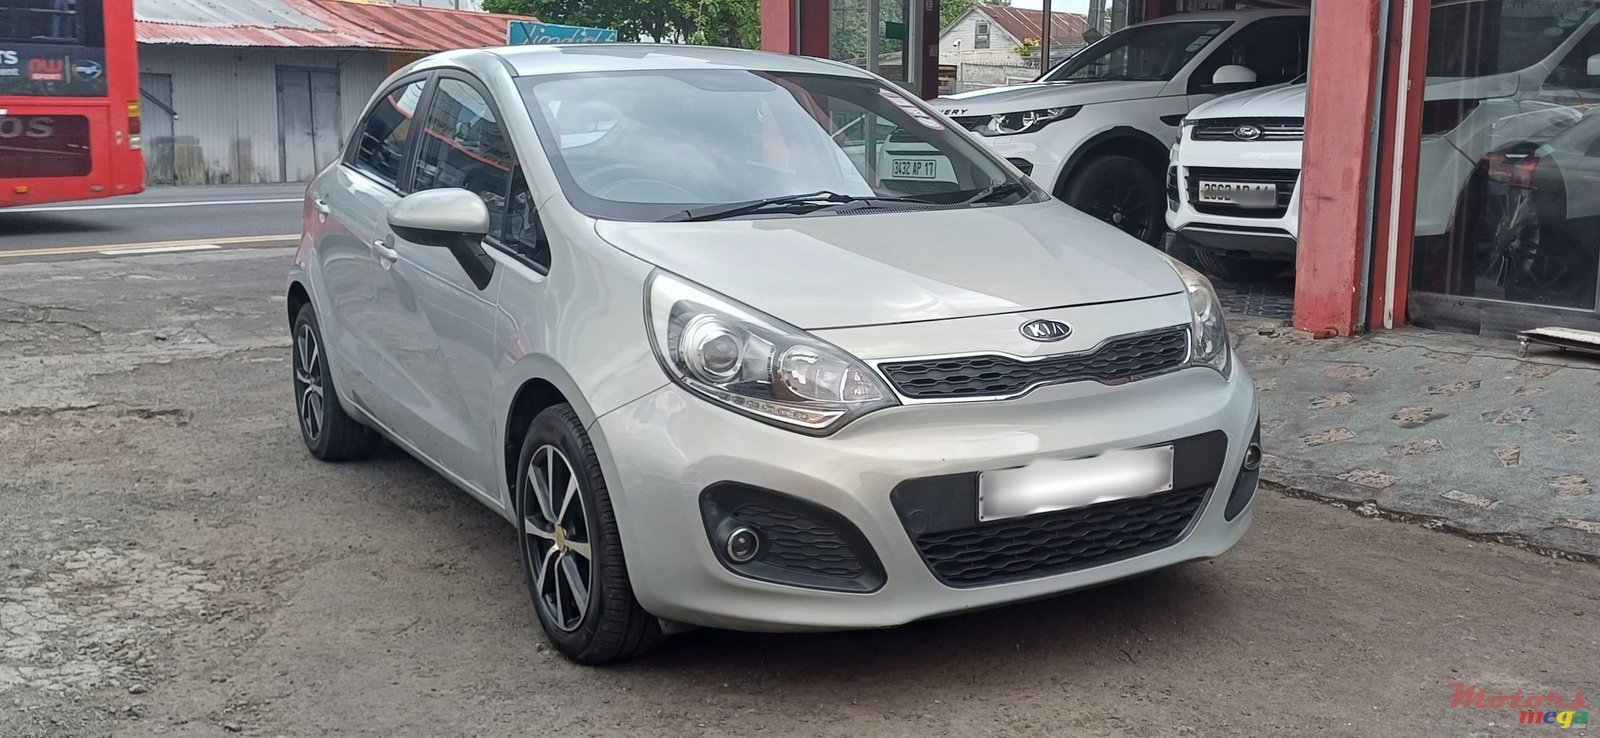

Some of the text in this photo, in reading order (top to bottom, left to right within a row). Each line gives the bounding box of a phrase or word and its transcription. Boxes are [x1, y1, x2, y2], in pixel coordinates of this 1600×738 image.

[894, 161, 934, 176] 3432 AP 17
[1028, 323, 1065, 337] KIA
